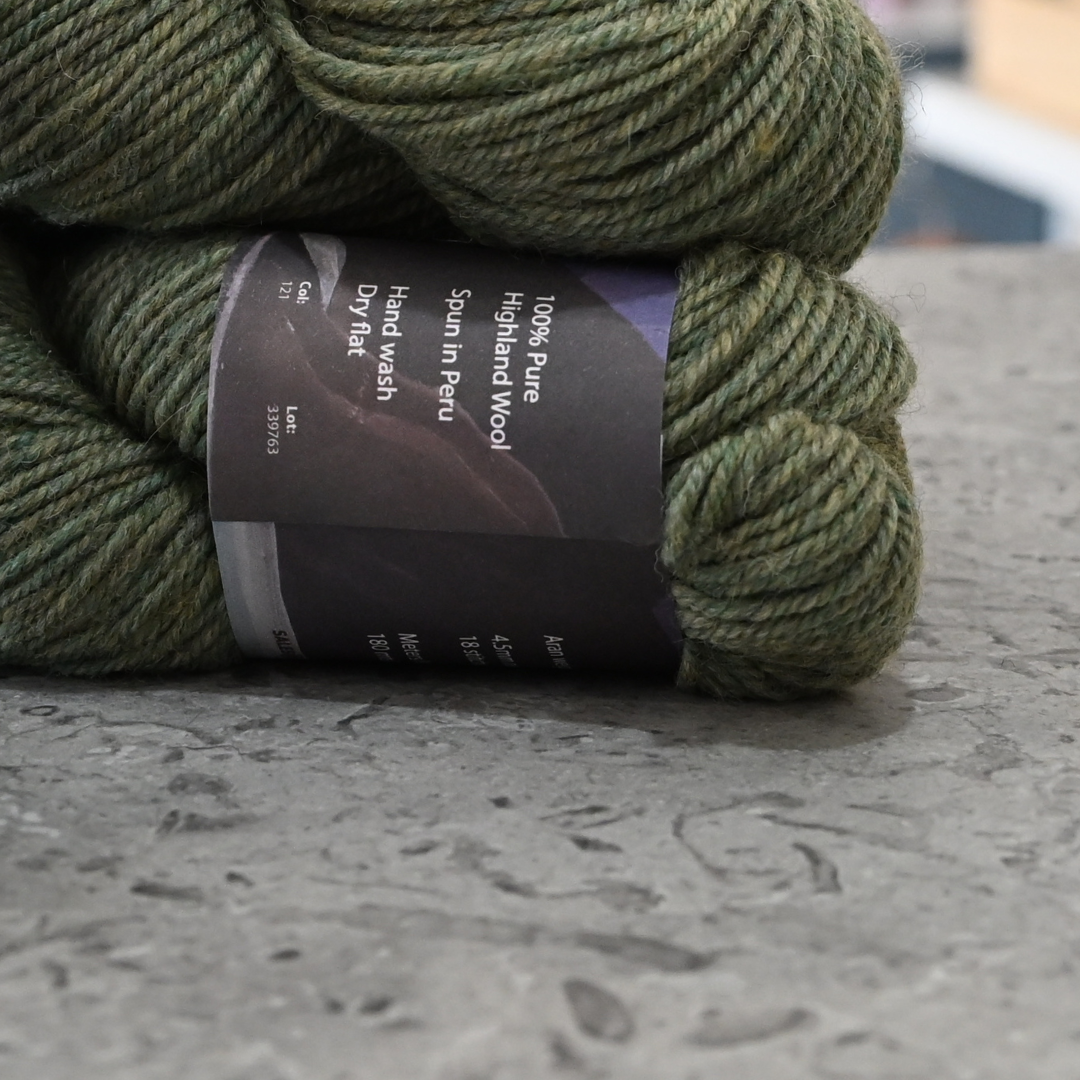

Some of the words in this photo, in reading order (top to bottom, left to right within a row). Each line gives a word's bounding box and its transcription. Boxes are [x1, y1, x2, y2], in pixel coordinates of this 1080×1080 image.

[278, 281, 293, 300] 121
[296, 281, 312, 305] Col:
[349, 284, 379, 318] Dry
[381, 285, 410, 337] Hand
[444, 288, 471, 337] Spun
[528, 295, 556, 347] 100%
[347, 321, 372, 357] flat
[441, 343, 463, 363] in
[492, 292, 524, 386] Highland
[376, 342, 398, 401] wash
[523, 352, 548, 404] Pure
[438, 370, 461, 422] Peru
[267, 405, 280, 455] 339763
[286, 406, 298, 434] Lot:
[489, 390, 512, 450] Wool
[366, 633, 389, 653] 180
[458, 635, 480, 649] 18
[543, 634, 565, 659] Aran
